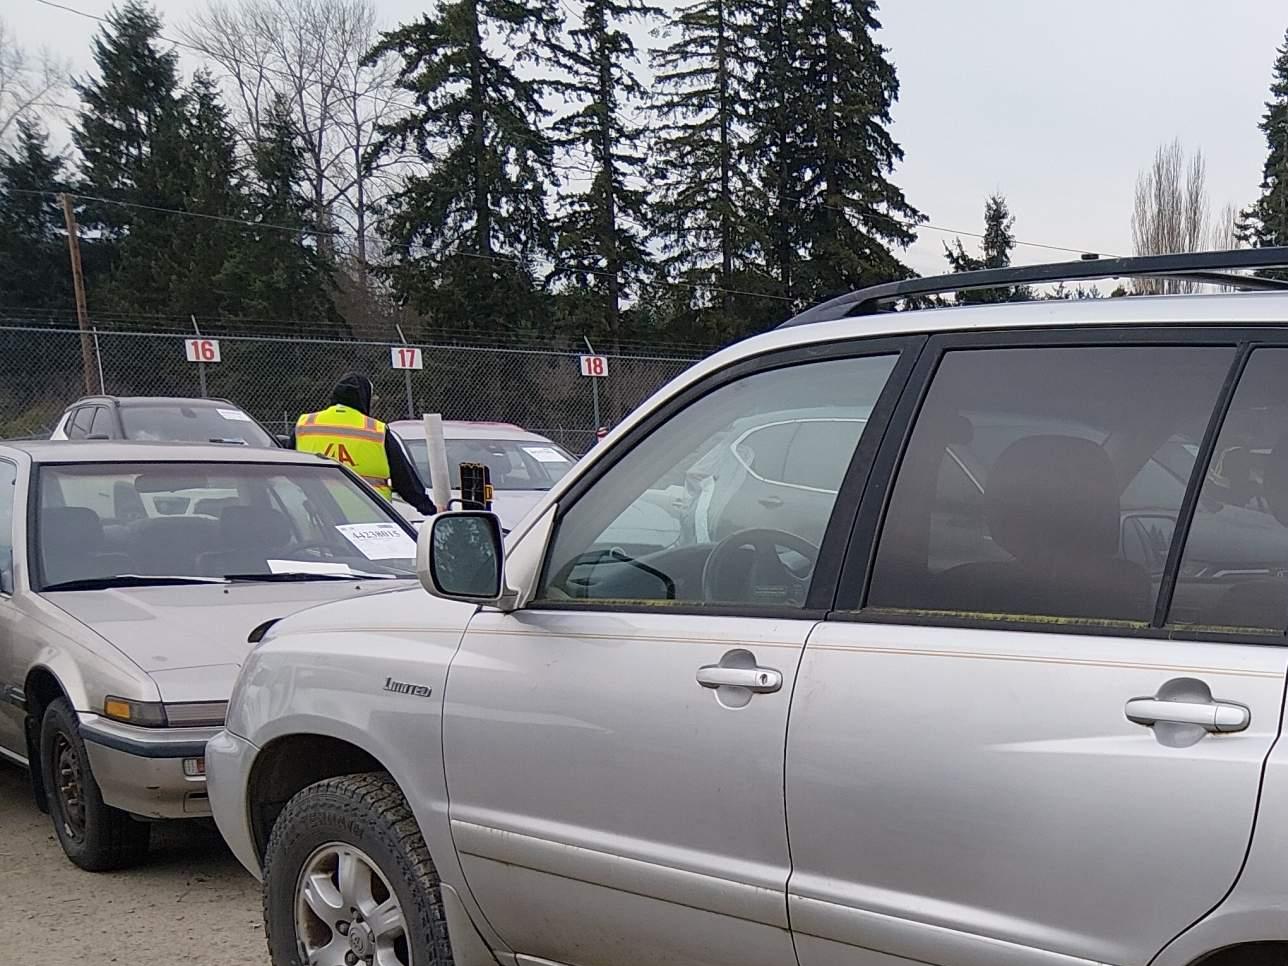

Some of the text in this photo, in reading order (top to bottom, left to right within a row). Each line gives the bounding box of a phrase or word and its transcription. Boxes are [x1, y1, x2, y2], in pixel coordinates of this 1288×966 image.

[191, 340, 215, 361] 16
[398, 349, 416, 368] 17
[585, 357, 604, 375] 18
